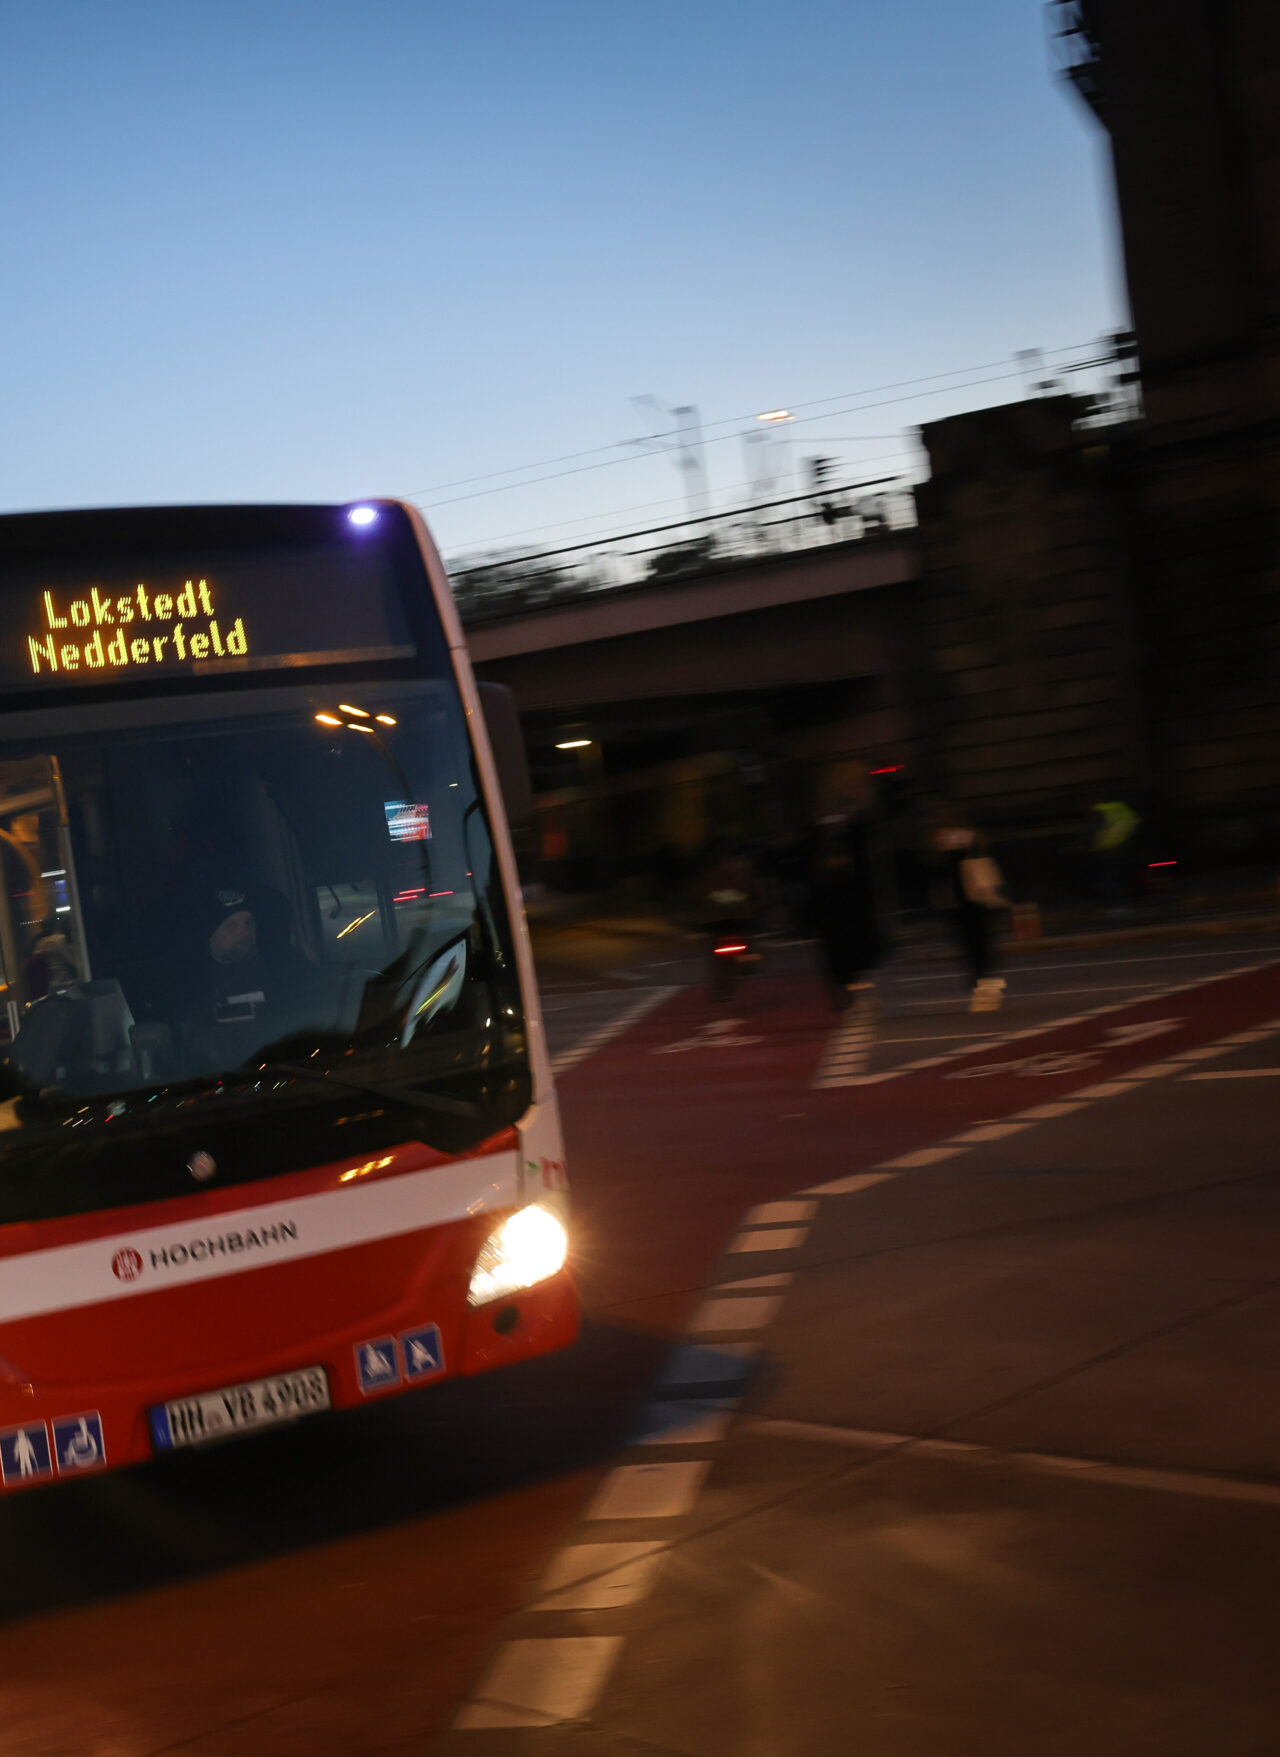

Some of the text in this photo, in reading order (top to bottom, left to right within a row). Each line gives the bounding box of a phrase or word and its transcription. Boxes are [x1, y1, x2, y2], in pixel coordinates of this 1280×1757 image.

[43, 579, 215, 629] Lokstedt
[28, 618, 248, 674] Nedderfeld
[149, 1219, 299, 1270] HOCHBAHN
